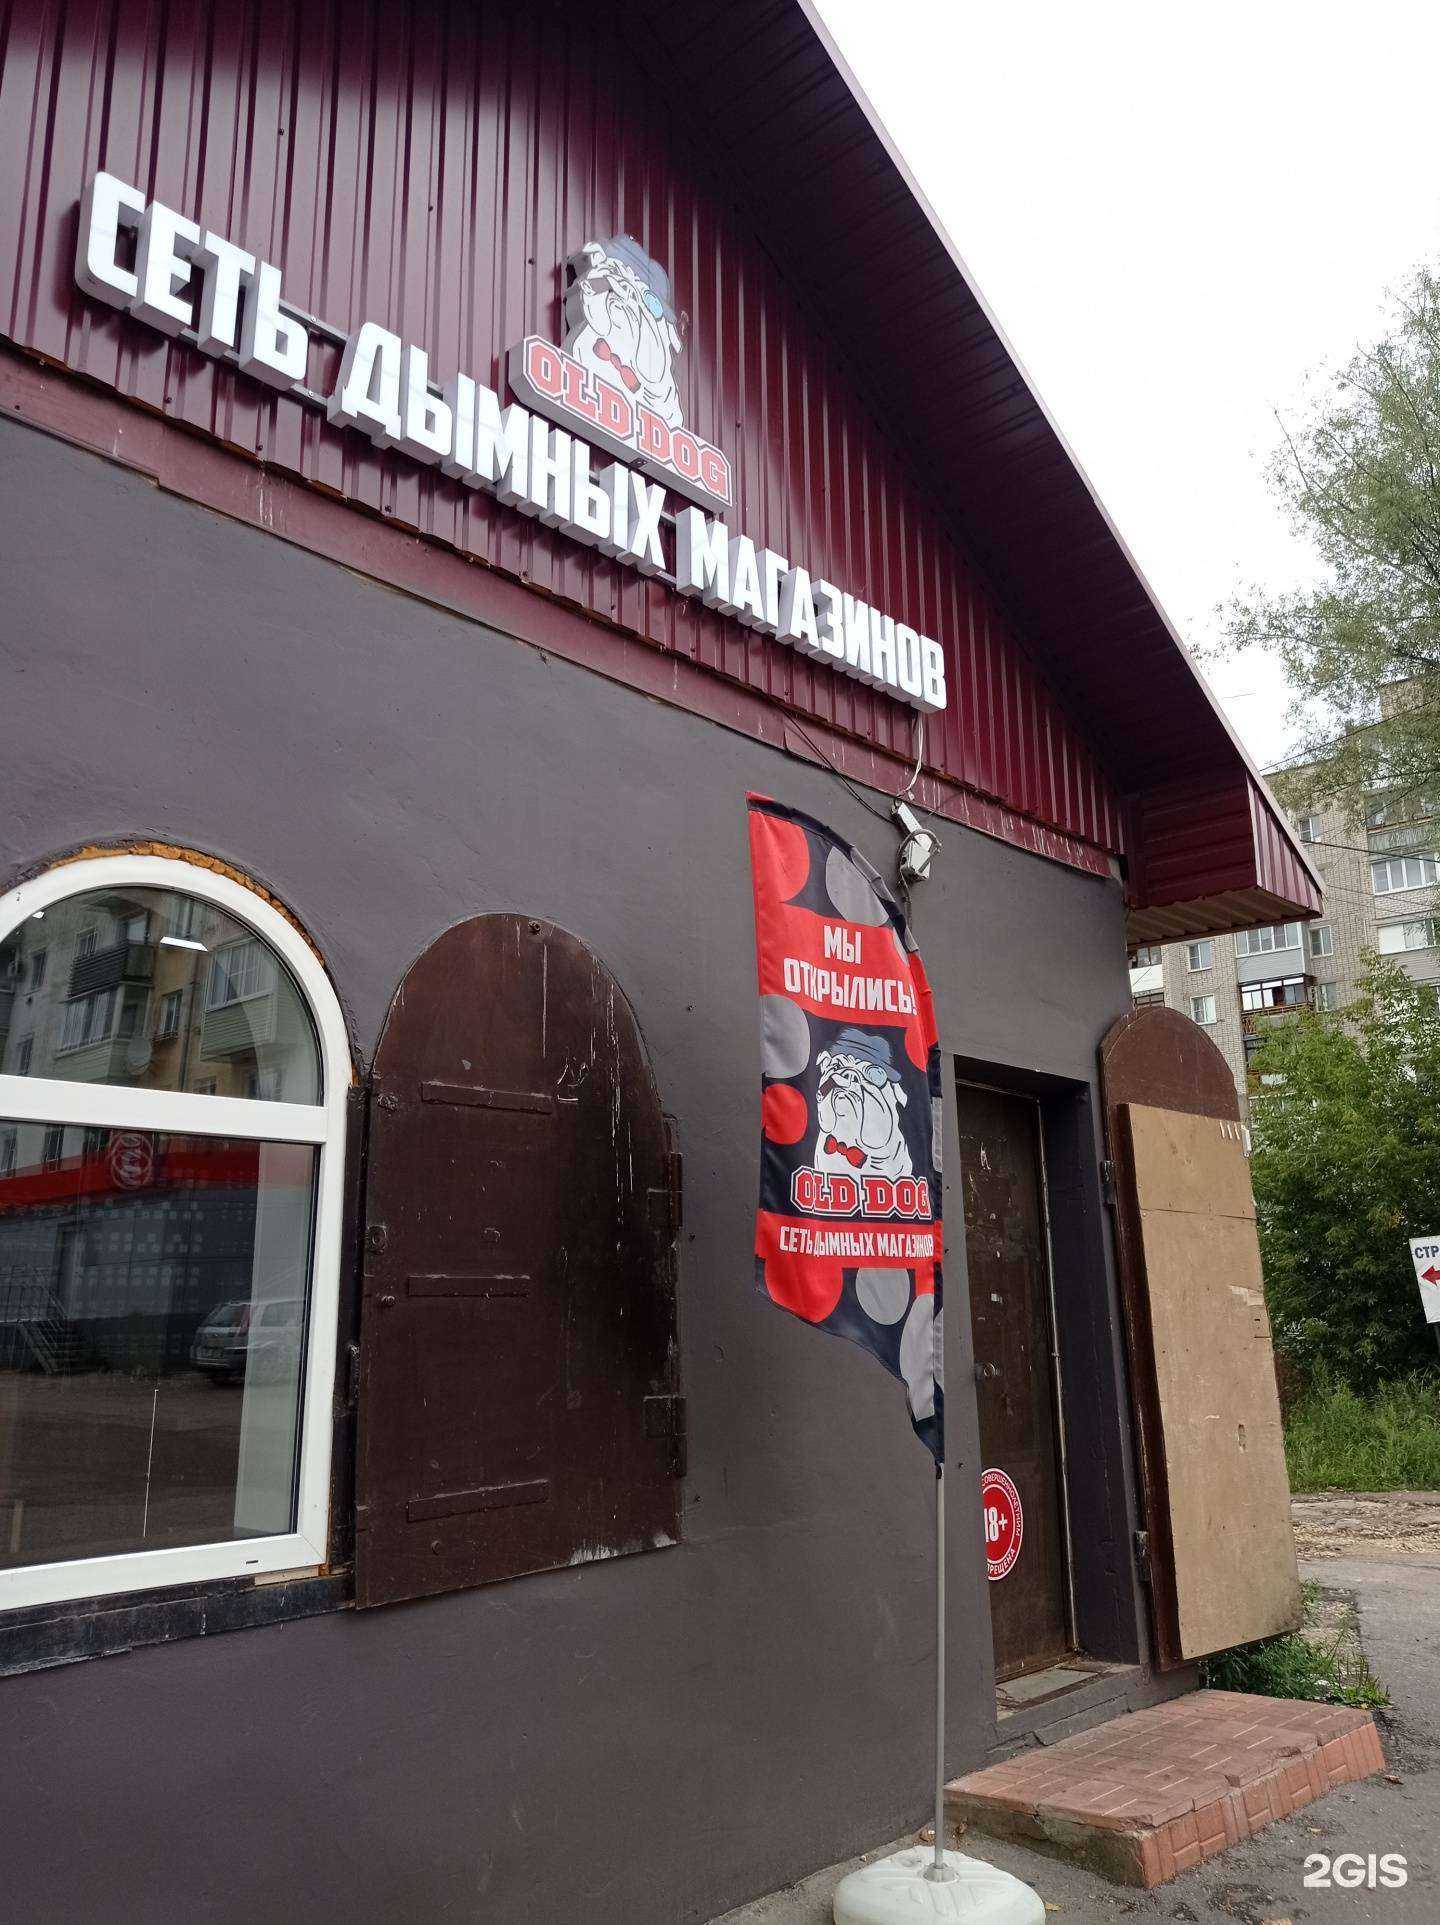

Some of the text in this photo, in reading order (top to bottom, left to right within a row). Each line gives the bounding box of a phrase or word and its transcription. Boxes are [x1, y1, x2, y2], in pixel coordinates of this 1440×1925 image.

[84, 171, 947, 711] СЕТЬ ДЫМНЫХ МАГАЗИНОВ
[527, 339, 729, 503] OLD DOG
[823, 925, 863, 964] МЫ
[784, 957, 918, 1015] ОТКРЫЛИСЬ!
[792, 1168, 931, 1219] OLD DOG
[779, 1226, 934, 1258] СЕТЬ ДЫМНЫХ МАГАЗИНОВ
[1414, 1245, 1440, 1259] СТР
[983, 1507, 1008, 1542] 18+
